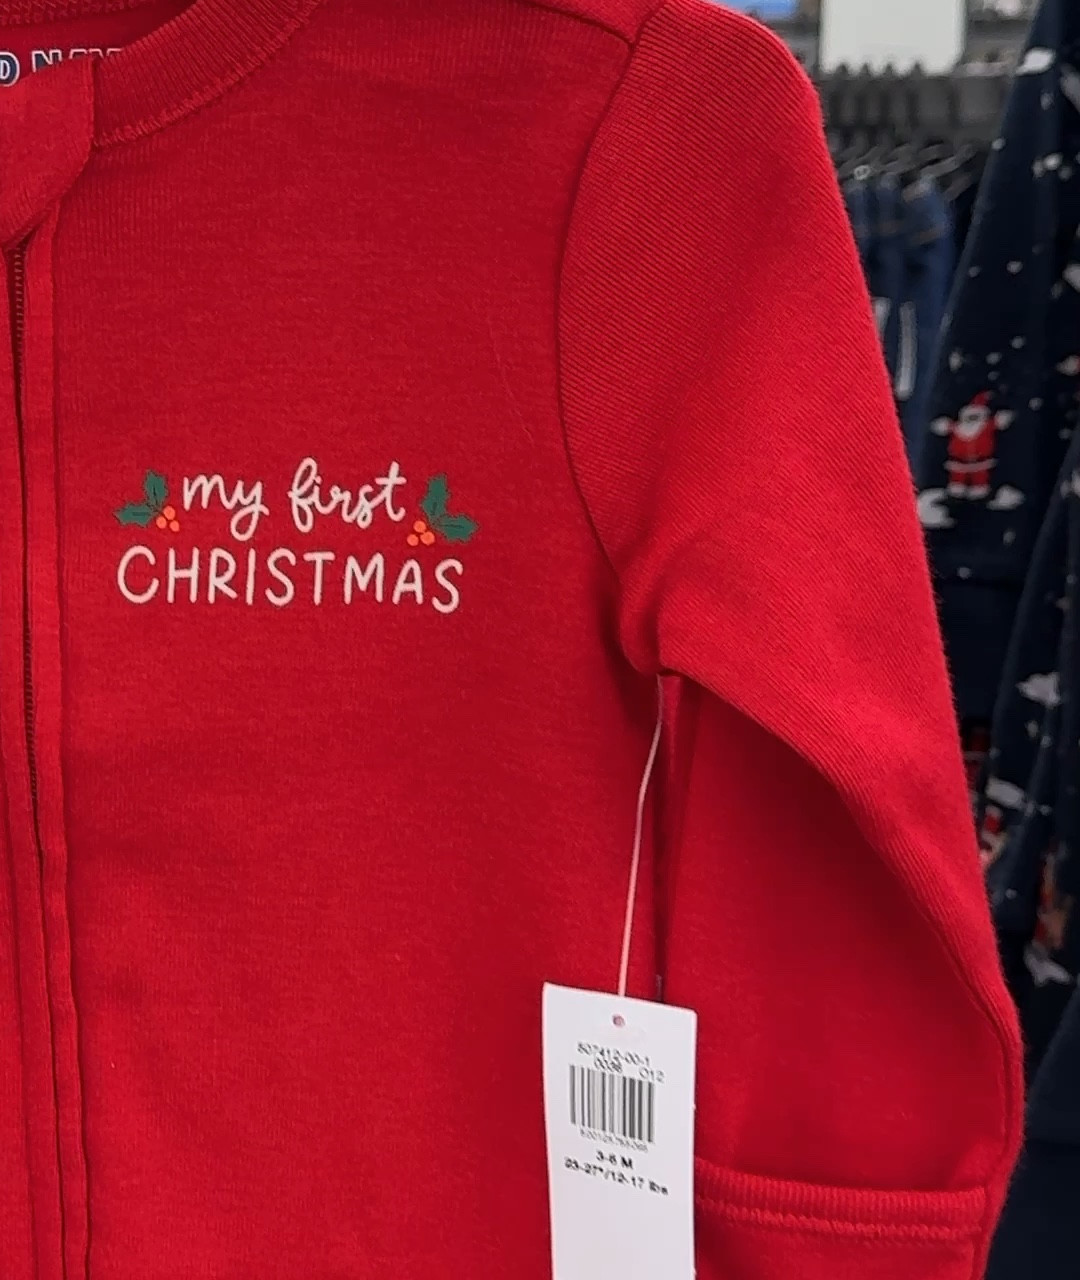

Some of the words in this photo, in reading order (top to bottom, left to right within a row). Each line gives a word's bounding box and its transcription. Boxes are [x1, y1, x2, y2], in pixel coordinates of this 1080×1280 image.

[183, 473, 270, 542] my
[287, 456, 408, 534] first
[116, 545, 464, 615] CHRISTMAS
[620, 1154, 634, 1170] M
